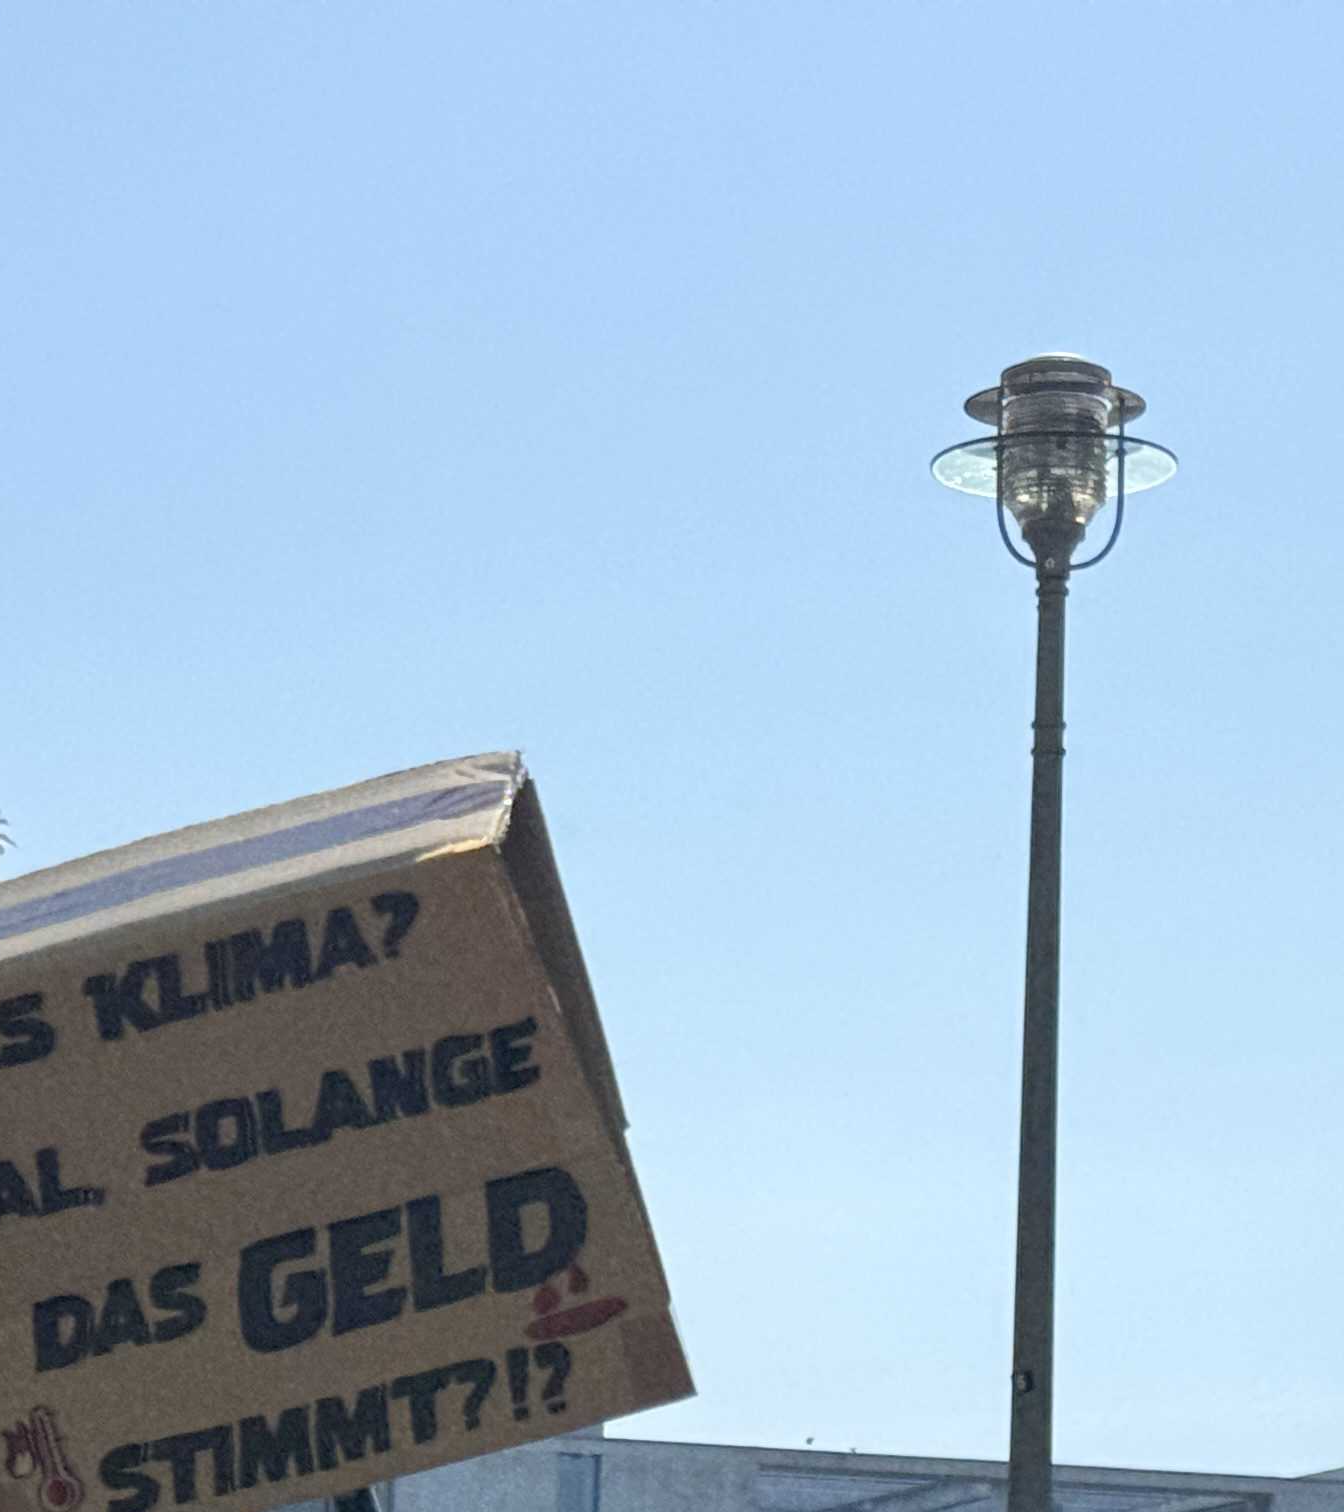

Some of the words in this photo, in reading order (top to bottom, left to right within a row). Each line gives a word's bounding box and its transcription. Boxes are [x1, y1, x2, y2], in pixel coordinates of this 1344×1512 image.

[83, 891, 420, 1042] KLIMA?
[140, 1016, 541, 1187] SOLANGE
[33, 1262, 207, 1373] DAS
[237, 1167, 588, 1354] GELD
